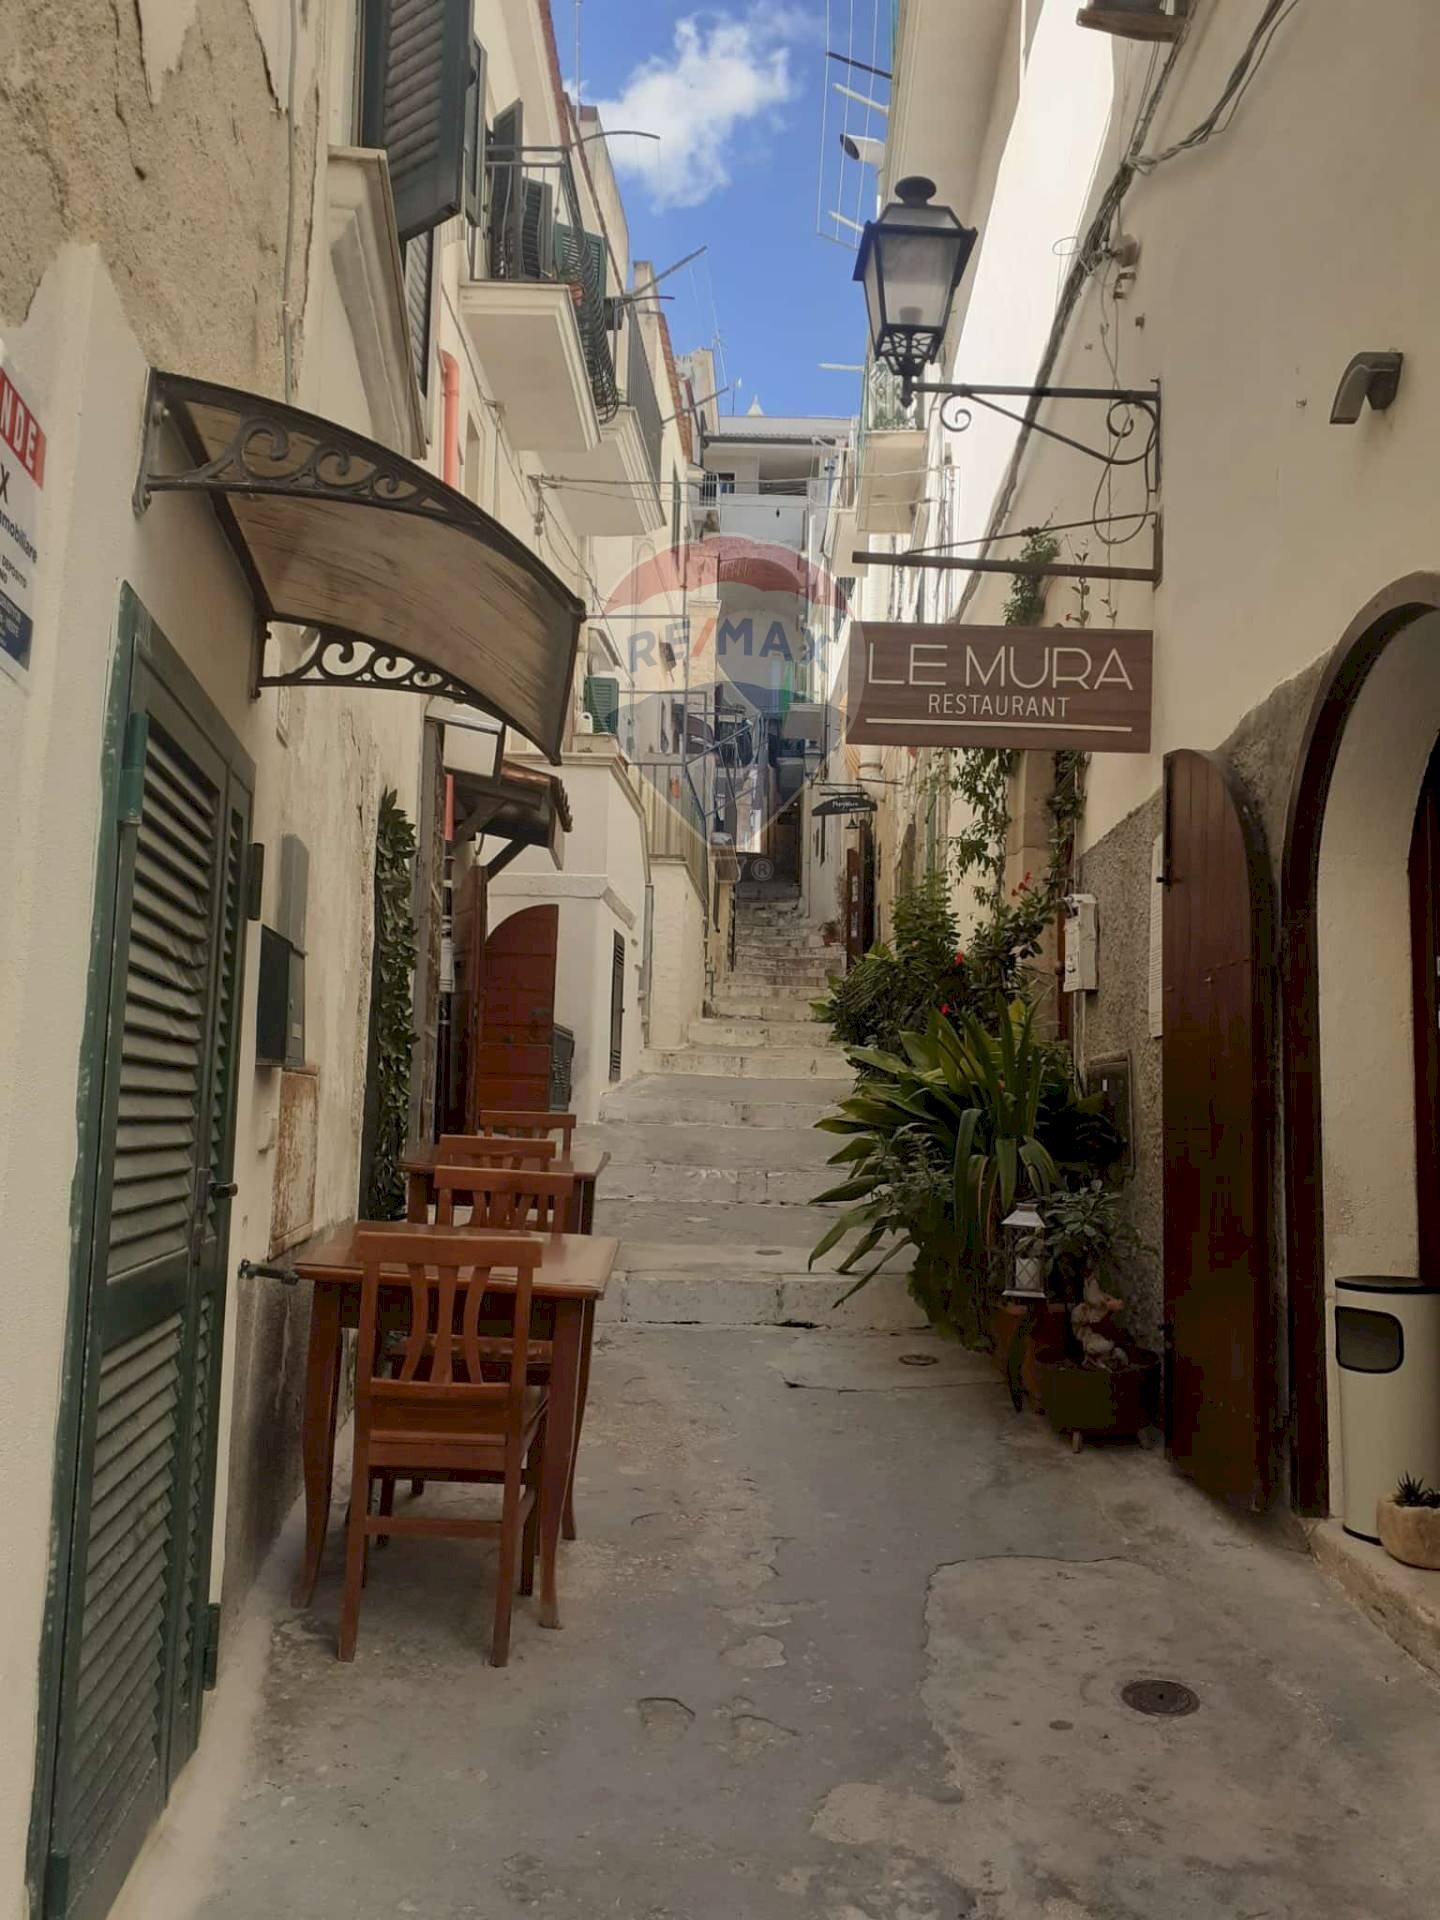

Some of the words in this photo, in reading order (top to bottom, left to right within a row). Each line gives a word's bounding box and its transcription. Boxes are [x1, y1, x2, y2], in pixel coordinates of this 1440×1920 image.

[0, 380, 37, 472] NDE
[868, 642, 949, 687] LE
[965, 644, 1134, 691] MURA
[928, 693, 1071, 718] RESTAURANT
